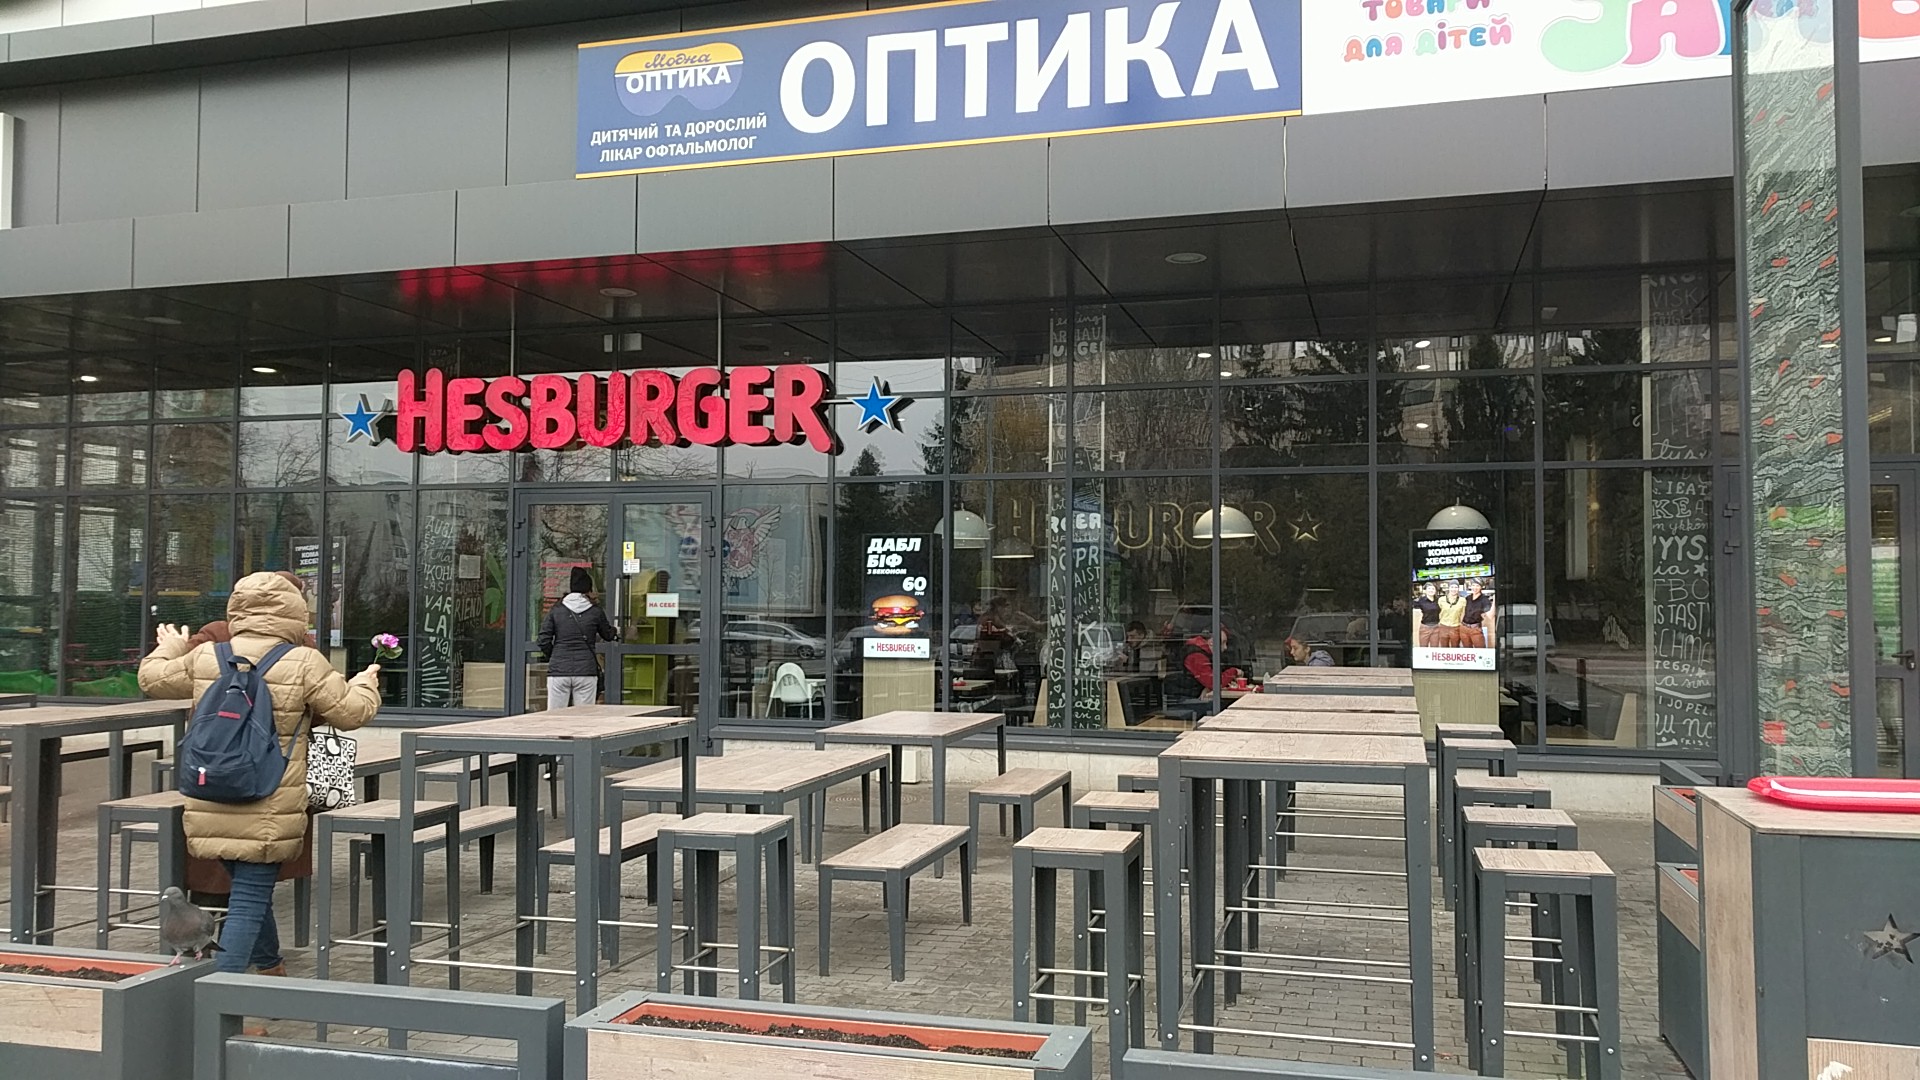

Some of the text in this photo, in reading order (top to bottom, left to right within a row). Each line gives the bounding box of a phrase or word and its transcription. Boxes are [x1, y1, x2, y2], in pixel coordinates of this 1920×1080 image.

[1344, 36, 1403, 62] ДЛЯ
[1415, 16, 1512, 56] ДІТЕЙ
[780, 0, 1279, 134] ОПТИКА
[625, 65, 732, 94] ОПТИКА
[590, 112, 767, 146] ДИТЯЧИЙ ТА ДОРОСЛИЙ
[599, 136, 758, 162] ЛІКАР ОФТАЛЬМОЛОГ
[397, 364, 834, 454] HESBURGER
[867, 538, 922, 554] ДАБЛ
[1417, 536, 1488, 549] ПРИЄДНАЙСЯ ДО
[1428, 545, 1477, 557] КОМАНДИ
[867, 553, 903, 568] БІФ
[1426, 554, 1483, 566] ХЕСБУРГЕР
[902, 576, 927, 591] 60
[876, 642, 916, 654] HESBURGER
[1432, 651, 1477, 663] HESBURGER
